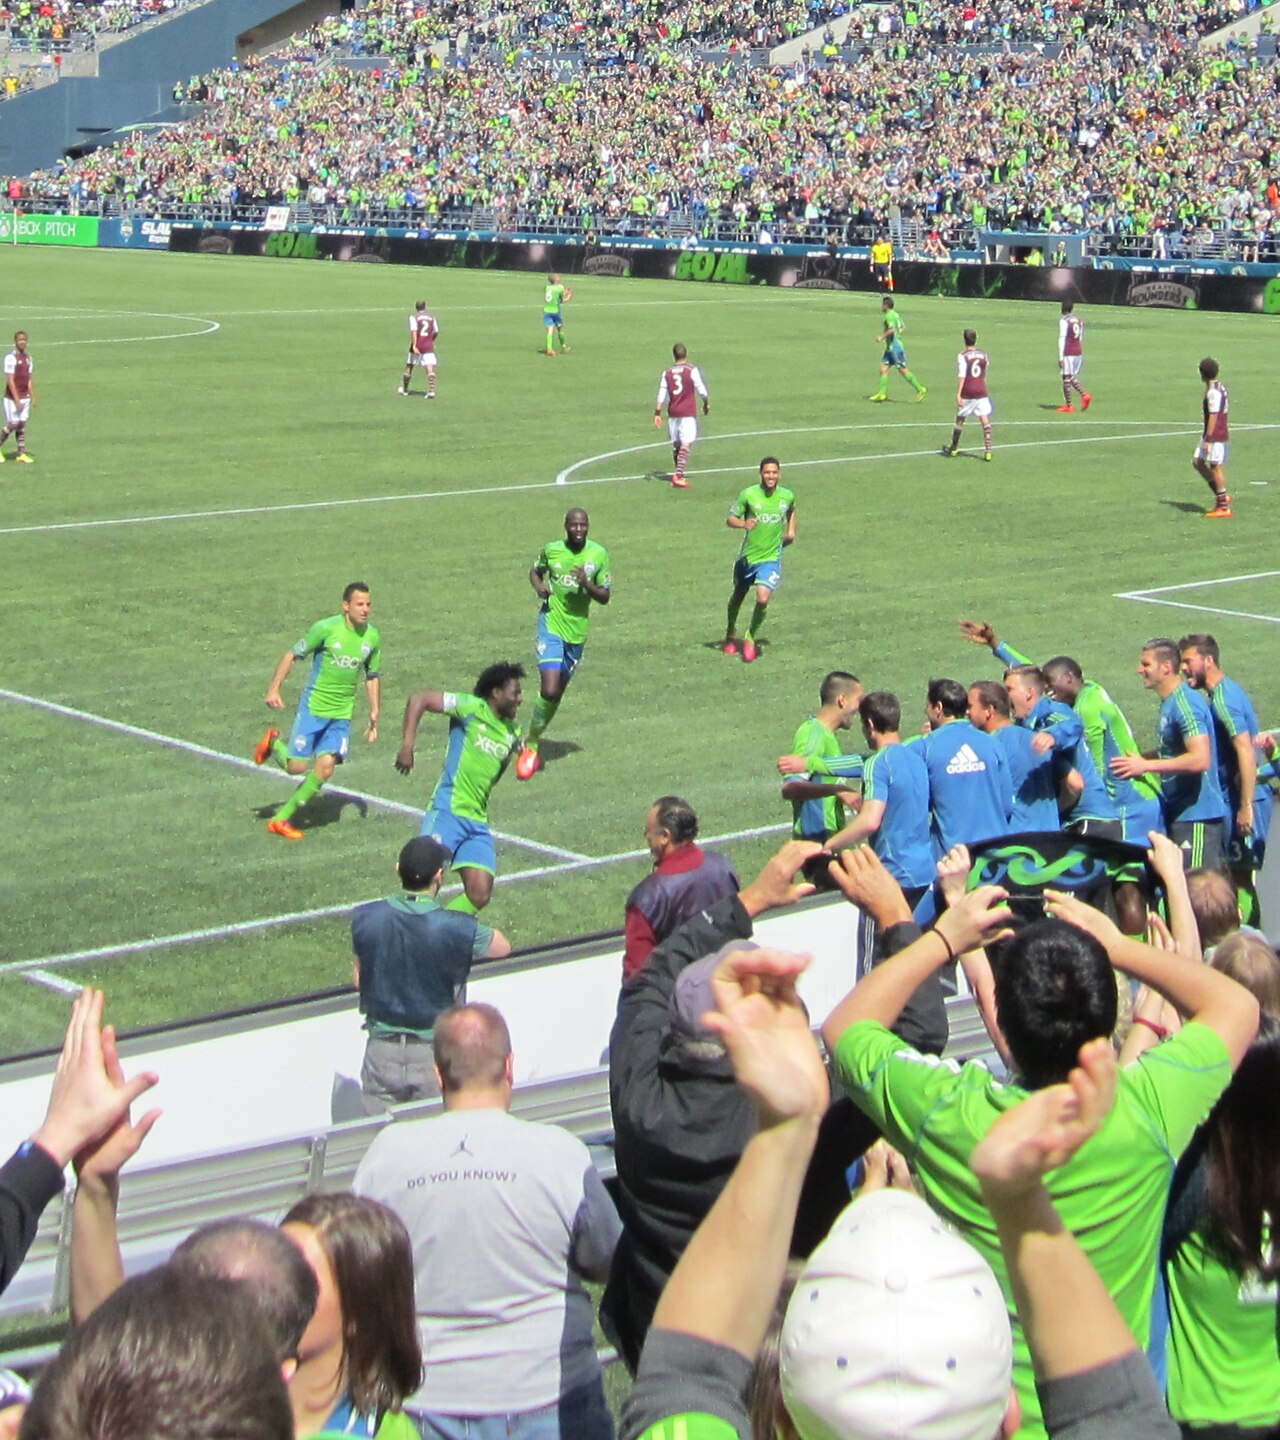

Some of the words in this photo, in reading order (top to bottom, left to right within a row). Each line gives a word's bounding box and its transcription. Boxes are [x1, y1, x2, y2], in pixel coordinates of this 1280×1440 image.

[13, 221, 41, 235] XBOX
[45, 222, 76, 238] PITCH
[267, 232, 318, 259] GOAL
[677, 250, 751, 283] GOAL
[420, 320, 429, 337] 2
[1072, 321, 1080, 338] 9
[971, 359, 982, 378] 6
[672, 373, 683, 396] 3
[946, 759, 986, 775] adidas
[406, 1176, 426, 1189] DO
[429, 1170, 459, 1184] YOU
[463, 1168, 518, 1183] KNOW?
